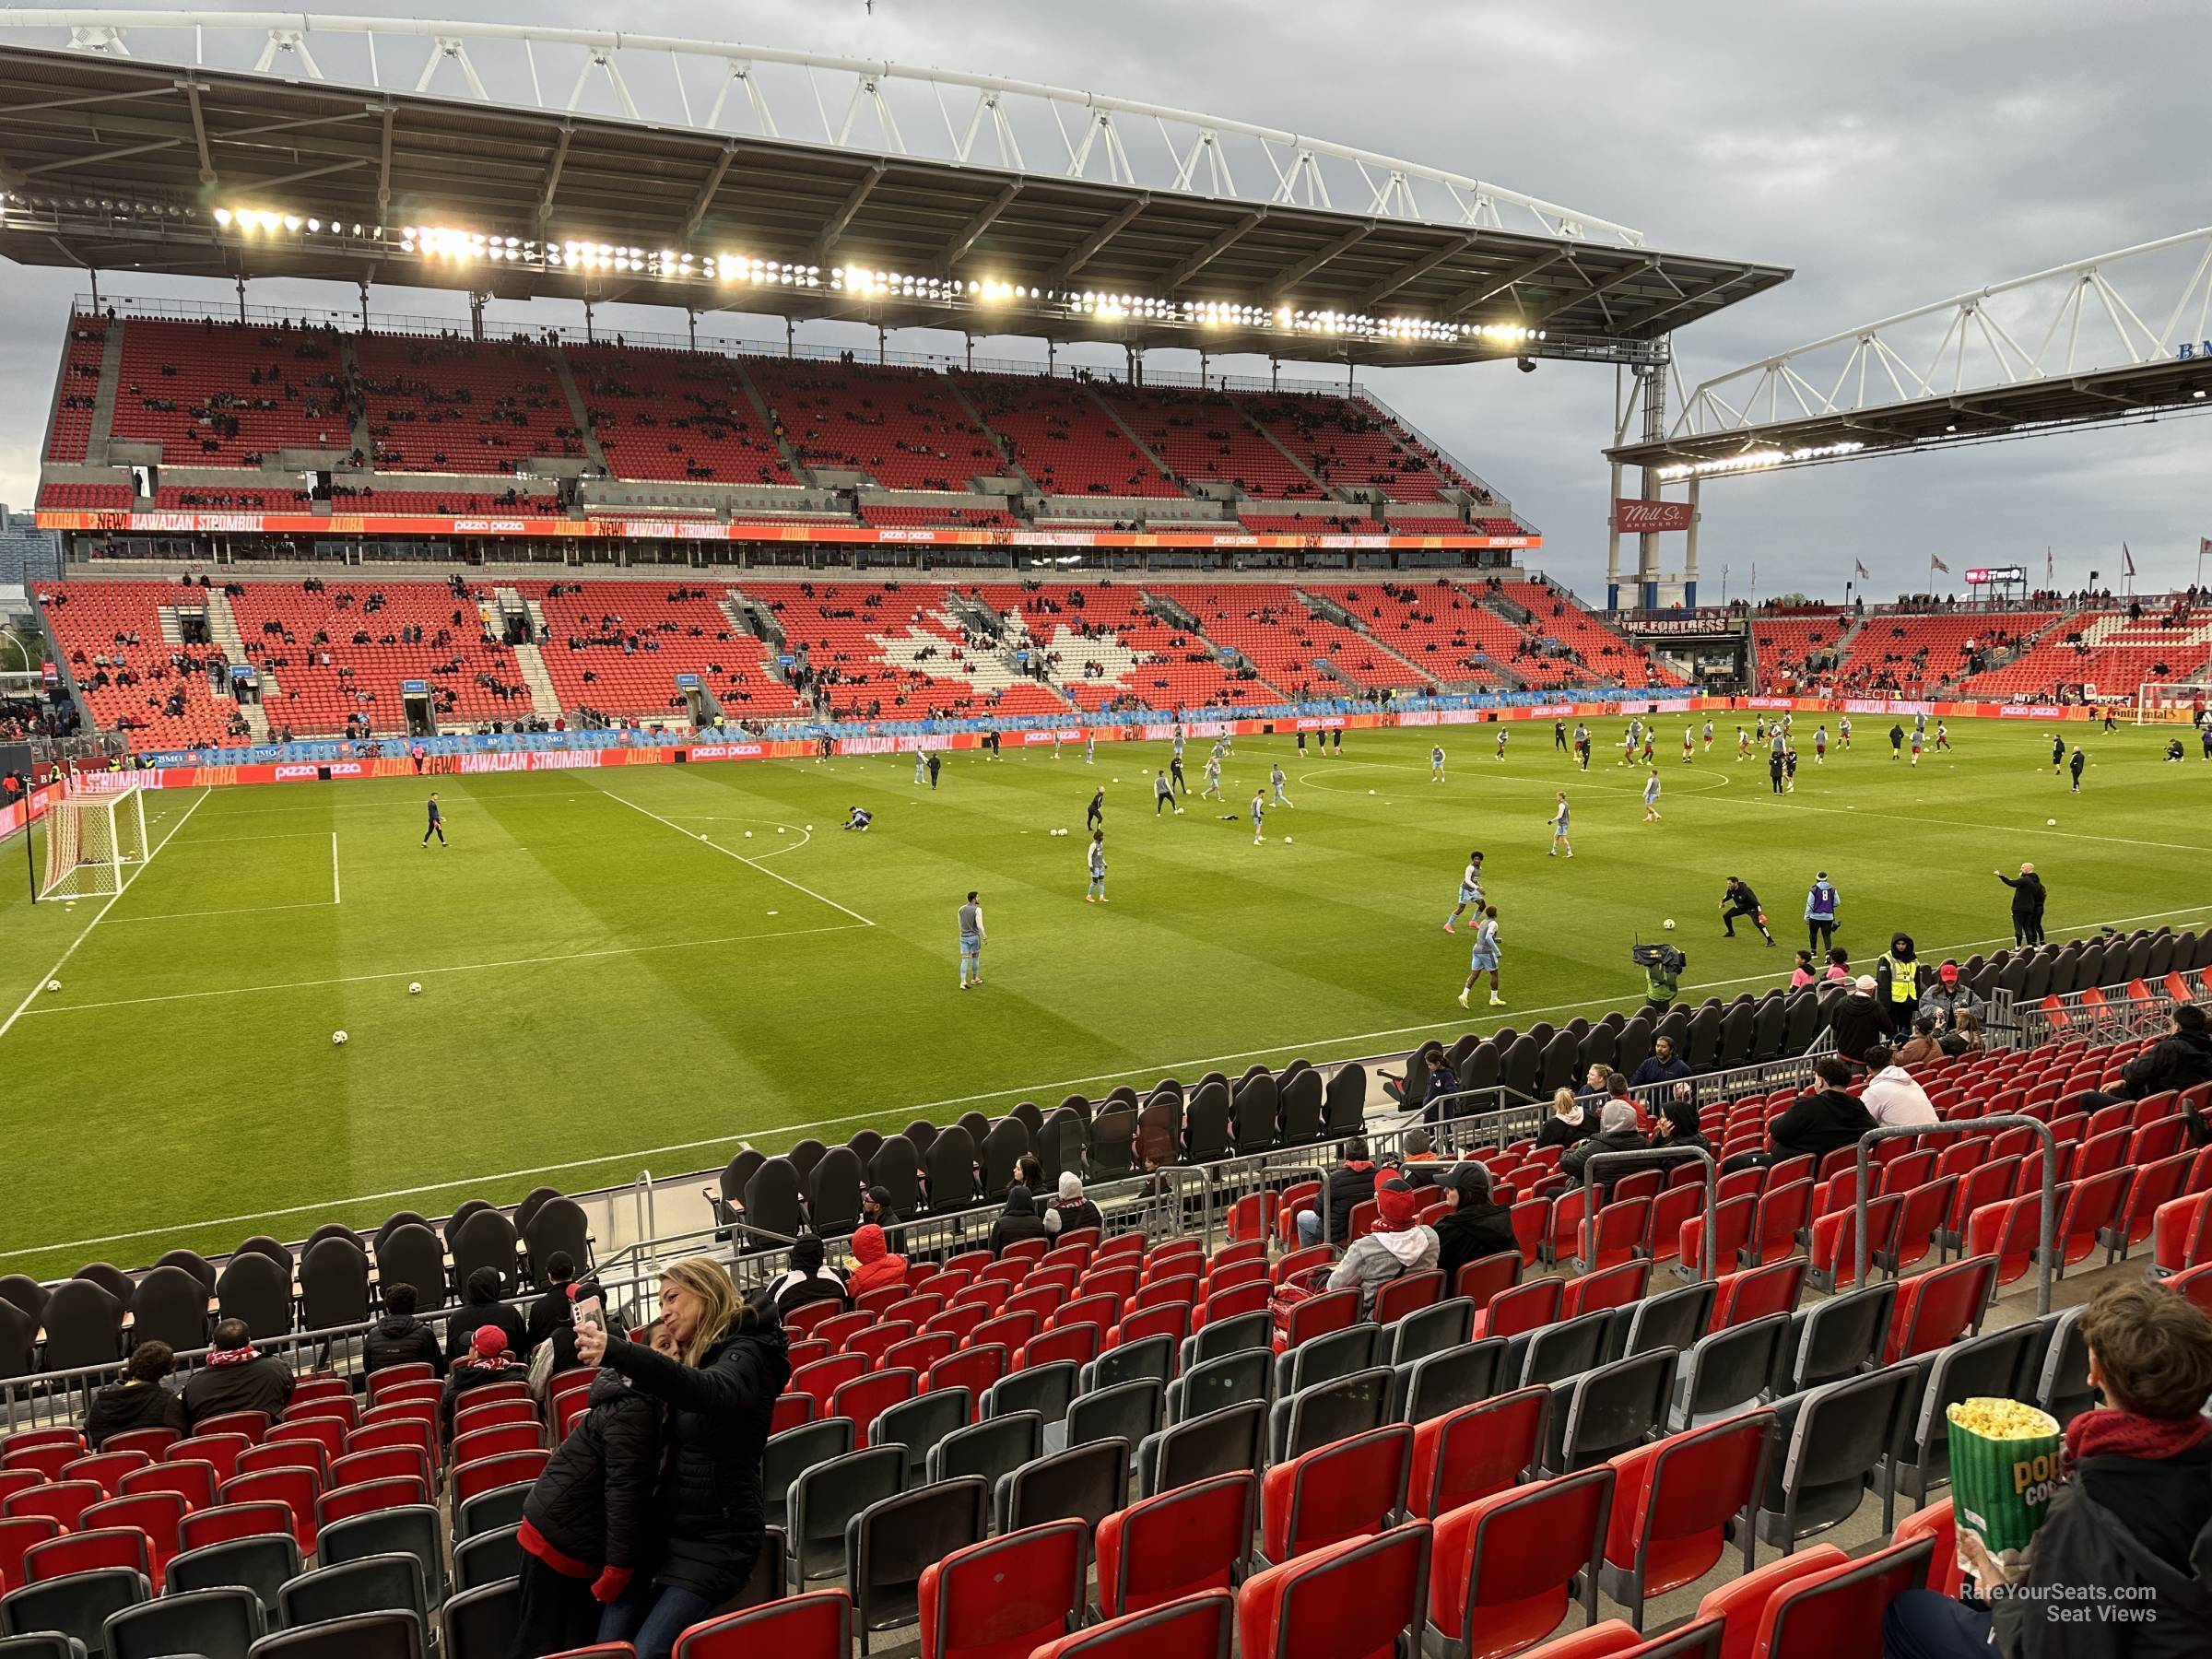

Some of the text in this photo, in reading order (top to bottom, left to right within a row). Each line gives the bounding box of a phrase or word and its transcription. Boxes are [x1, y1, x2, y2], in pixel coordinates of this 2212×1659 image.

[1622, 505, 1662, 522] Mill
[41, 514, 80, 529] ALOHA
[98, 513, 264, 532] NEW! HAWAIIAN STROMBOLI
[329, 518, 364, 533] ALOHA
[454, 521, 524, 534] pizza pizza
[553, 521, 585, 535] ALOHA
[599, 522, 730, 539] NEW! HAWAIIAN STROMBOLI
[879, 531, 935, 542] pizza pizza
[1622, 618, 1725, 631] THE FORTRESS
[1856, 688, 1896, 700] SECTO
[2001, 706, 2060, 718] pizza pizza
[692, 745, 761, 759] pizza pizza
[771, 741, 803, 758] ALOHA
[841, 737, 894, 754] HAWAIIAN
[898, 735, 954, 753] STROMBOLI
[159, 755, 182, 763] BMO
[462, 752, 527, 773] HAWAIIAN
[532, 749, 602, 771] STROMBOLI
[276, 765, 317, 781] pizza
[371, 757, 414, 777] ALOHA
[193, 766, 237, 785] ALOHA
[1822, 889, 1828, 901] 8
